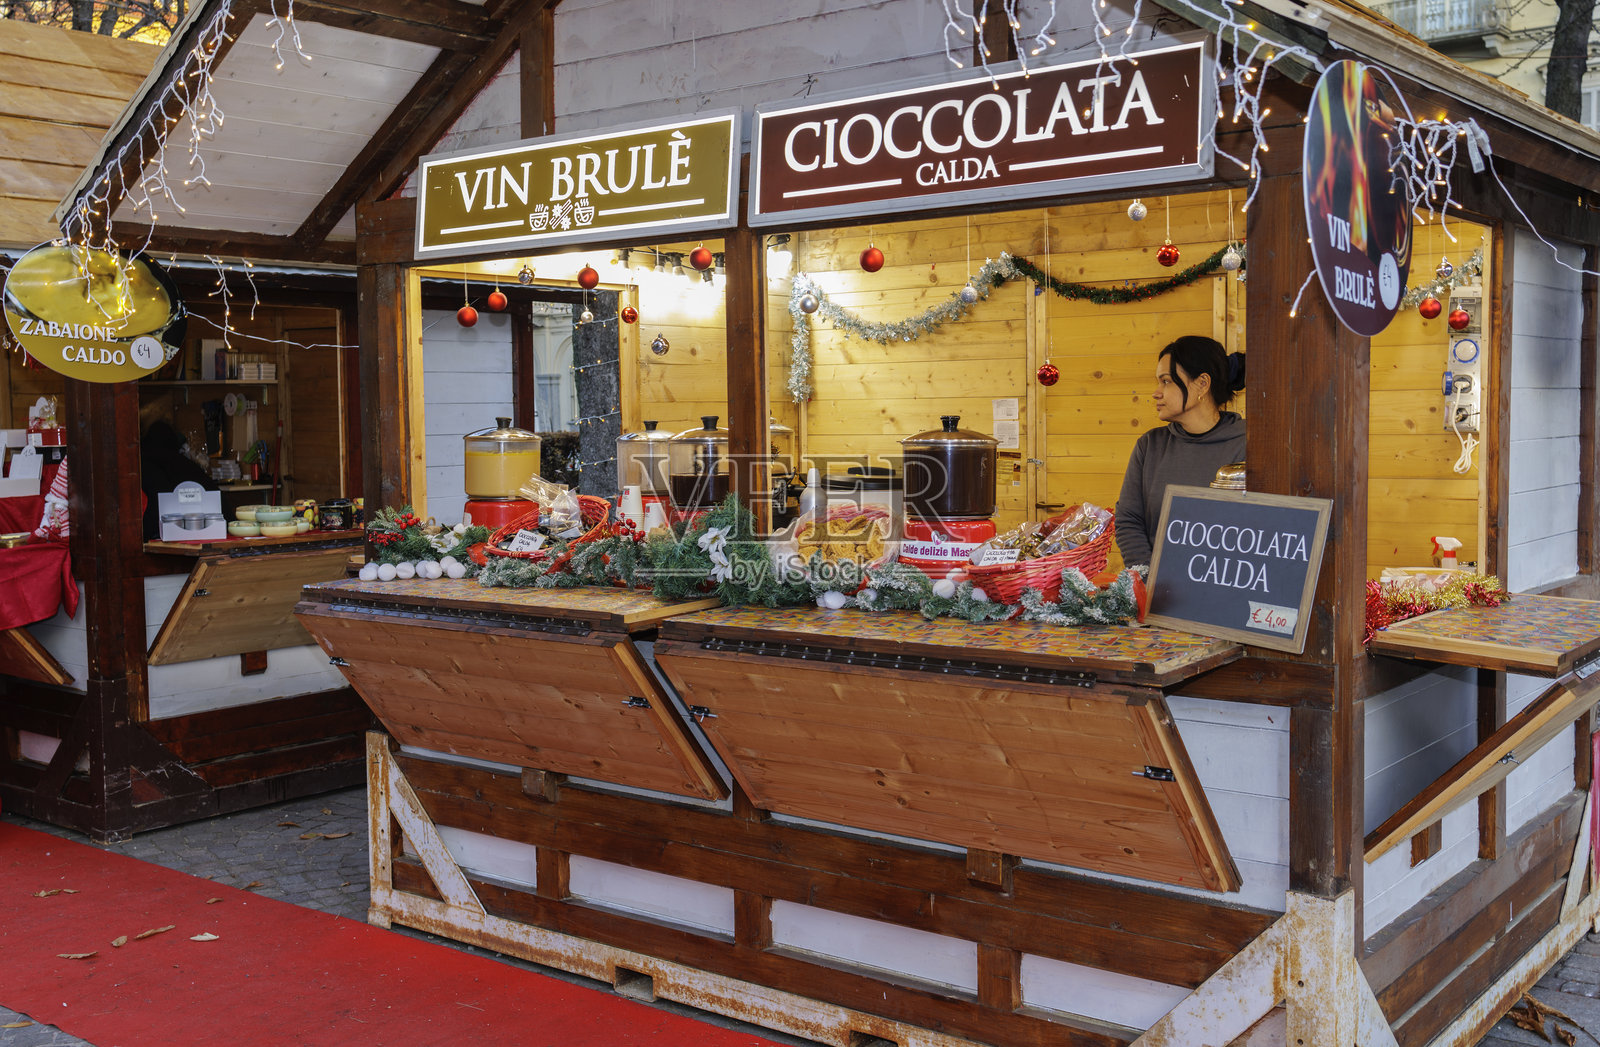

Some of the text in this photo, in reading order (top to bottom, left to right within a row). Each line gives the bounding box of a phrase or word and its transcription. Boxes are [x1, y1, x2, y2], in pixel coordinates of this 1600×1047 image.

[783, 69, 1165, 173] CIOCCOLATA
[454, 130, 692, 213] VIN BRULÈ
[915, 154, 1001, 187] CALDA
[1326, 212, 1351, 254] VIN
[1334, 266, 1377, 310] BRULÈ
[19, 318, 119, 343] ZABAIONE
[61, 345, 127, 366] CALDO
[137, 343, 151, 359] €4
[902, 543, 919, 555] Calde
[919, 545, 949, 557] delizie
[1166, 519, 1309, 562] CIOCCOLATA
[1187, 553, 1270, 593] CALDA
